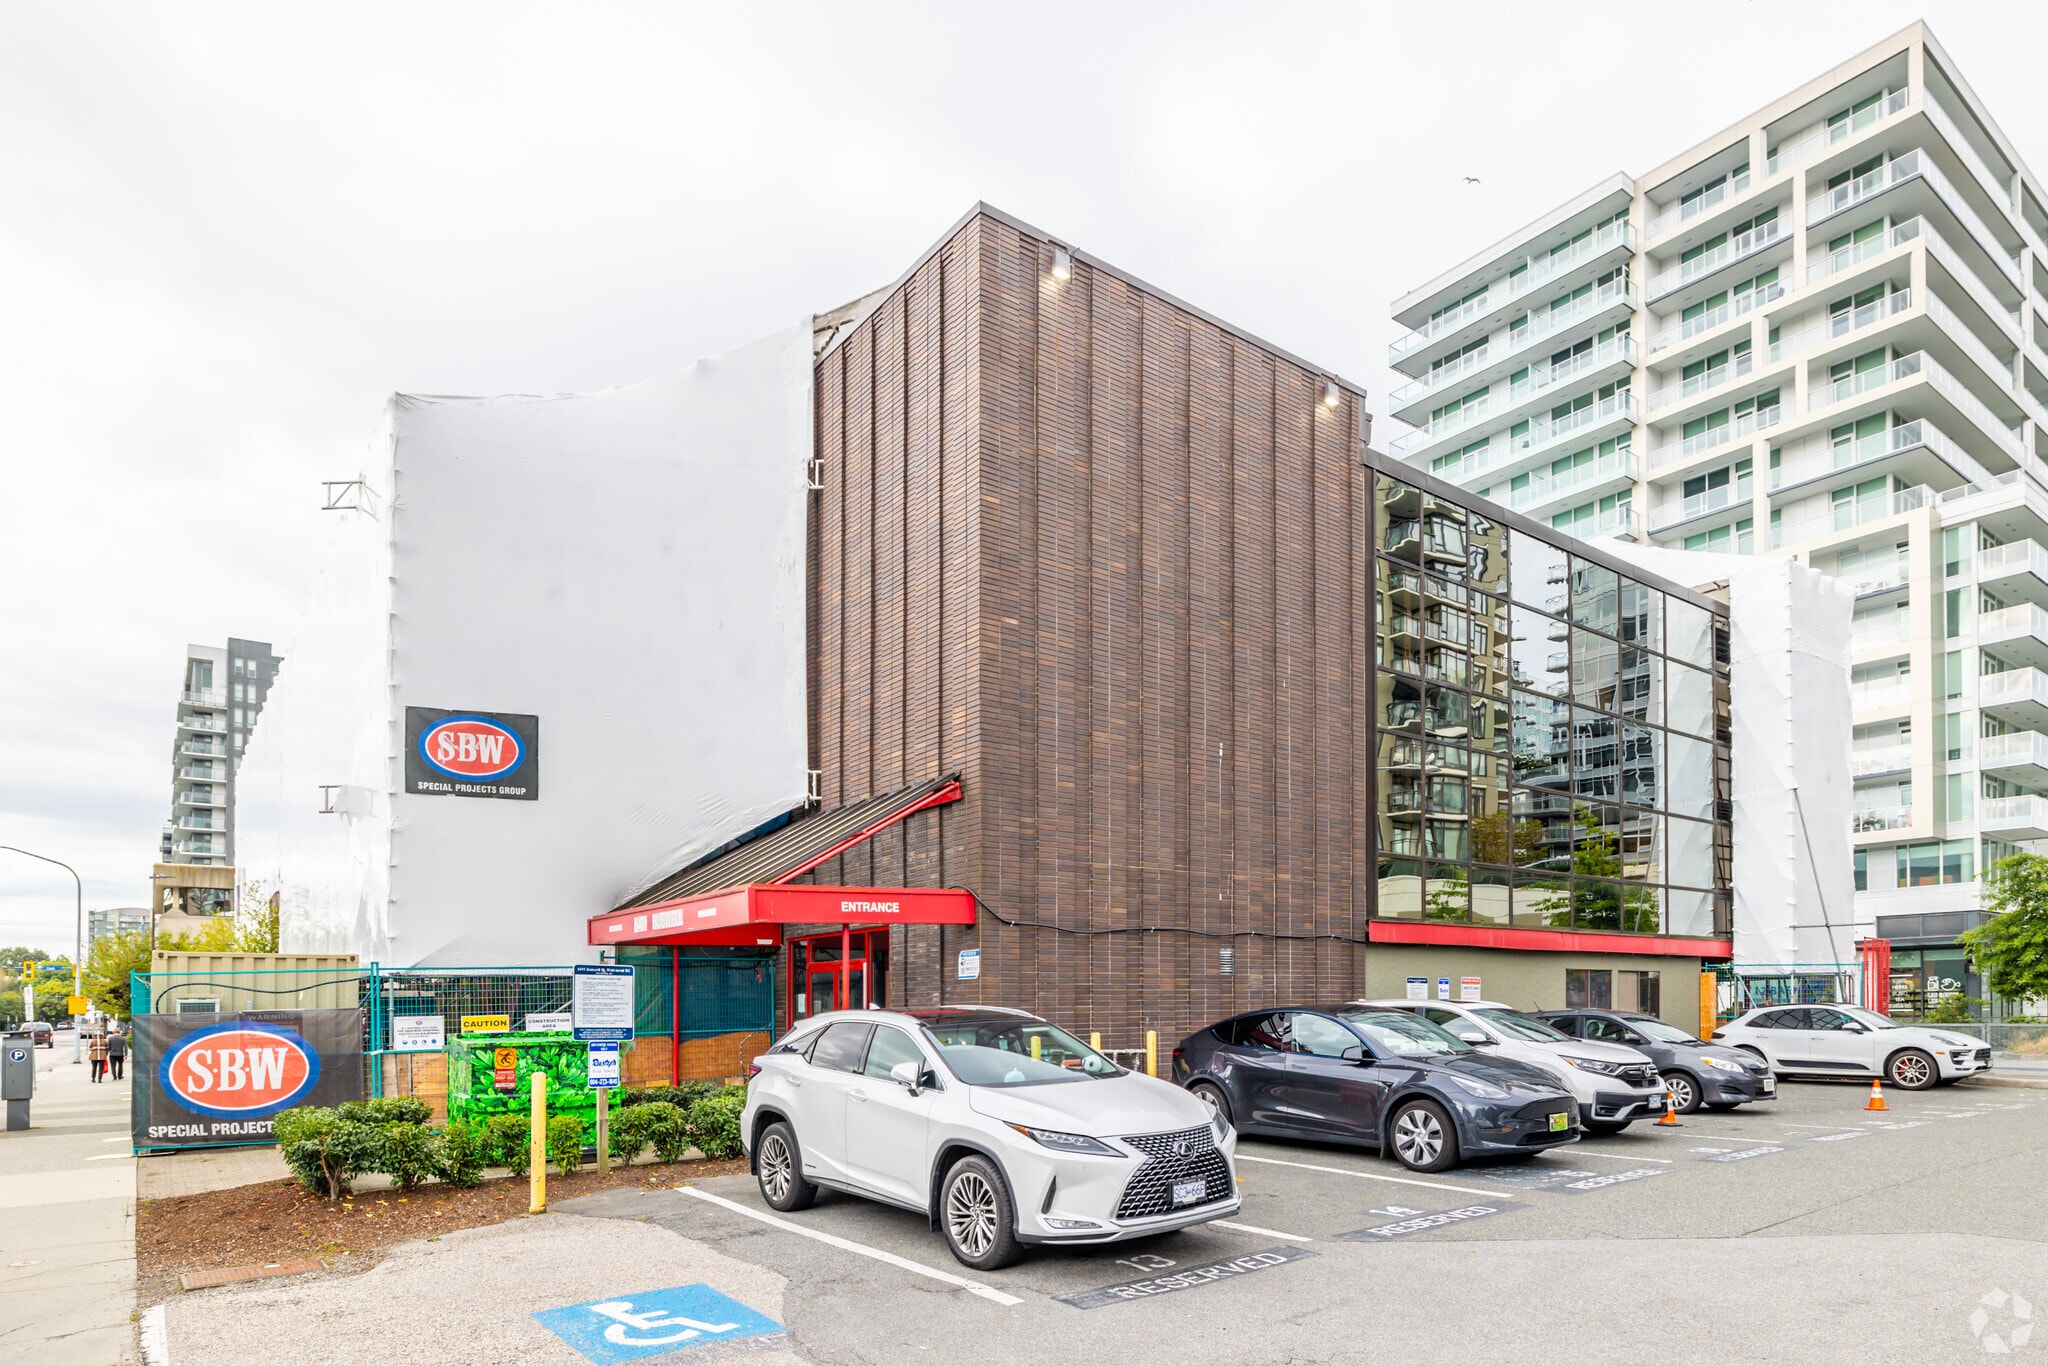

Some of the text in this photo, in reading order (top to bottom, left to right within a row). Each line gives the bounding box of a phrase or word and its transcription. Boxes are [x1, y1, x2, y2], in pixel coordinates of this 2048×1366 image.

[417, 781, 527, 795] SPECIAL PROJECTS GROUP
[841, 901, 900, 913] ENTRANCE
[463, 1019, 507, 1028] CAUTION
[148, 1121, 274, 1138] SPECIAL PROJECT
[1368, 1205, 1425, 1218] 14
[1366, 1206, 1498, 1236] RESERVED
[1115, 1254, 1177, 1272] 13
[1107, 1253, 1288, 1298] RESERVED
